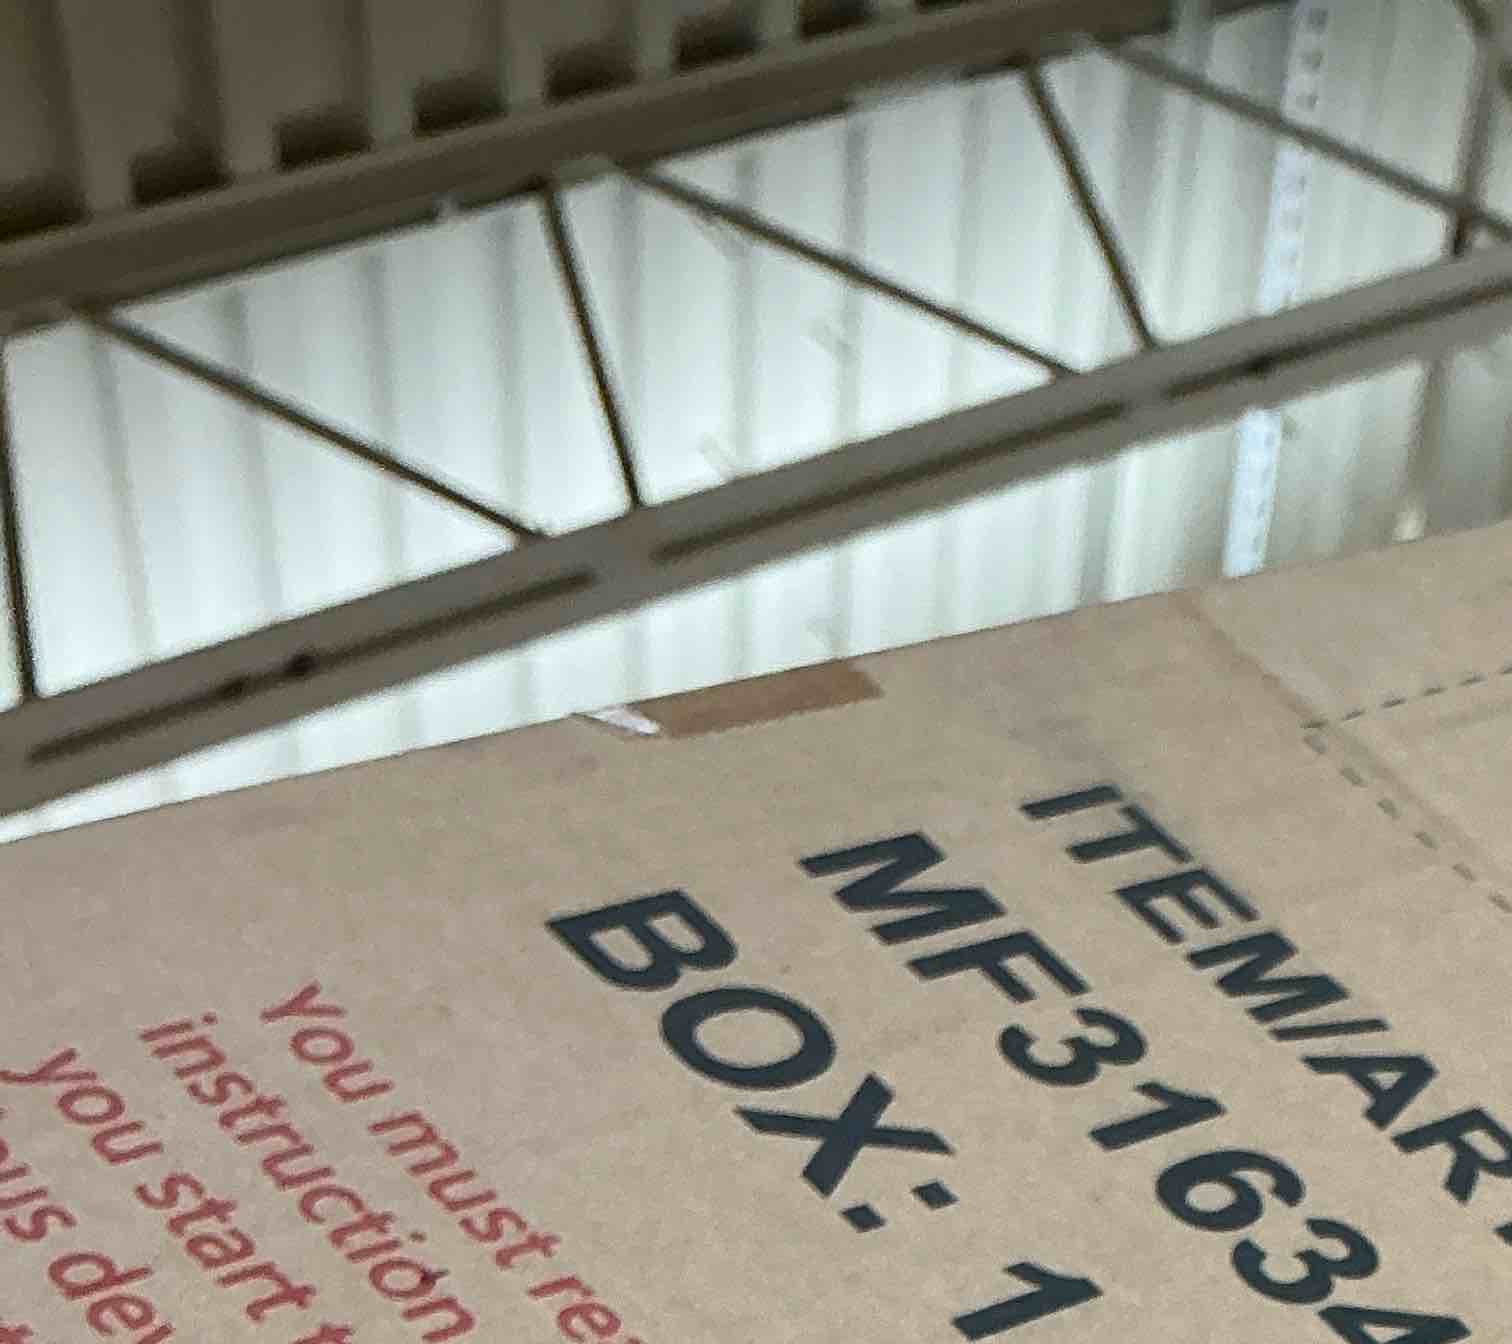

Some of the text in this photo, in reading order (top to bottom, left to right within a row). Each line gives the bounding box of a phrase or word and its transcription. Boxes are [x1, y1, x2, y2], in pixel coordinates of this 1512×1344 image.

[0, 1048, 164, 1166] you
[135, 1173, 316, 1323] start
[139, 1012, 476, 1343] instruction
[260, 979, 394, 1102] You
[369, 1110, 561, 1268] must
[545, 890, 957, 1232] BOX:
[952, 1260, 1102, 1342] 1
